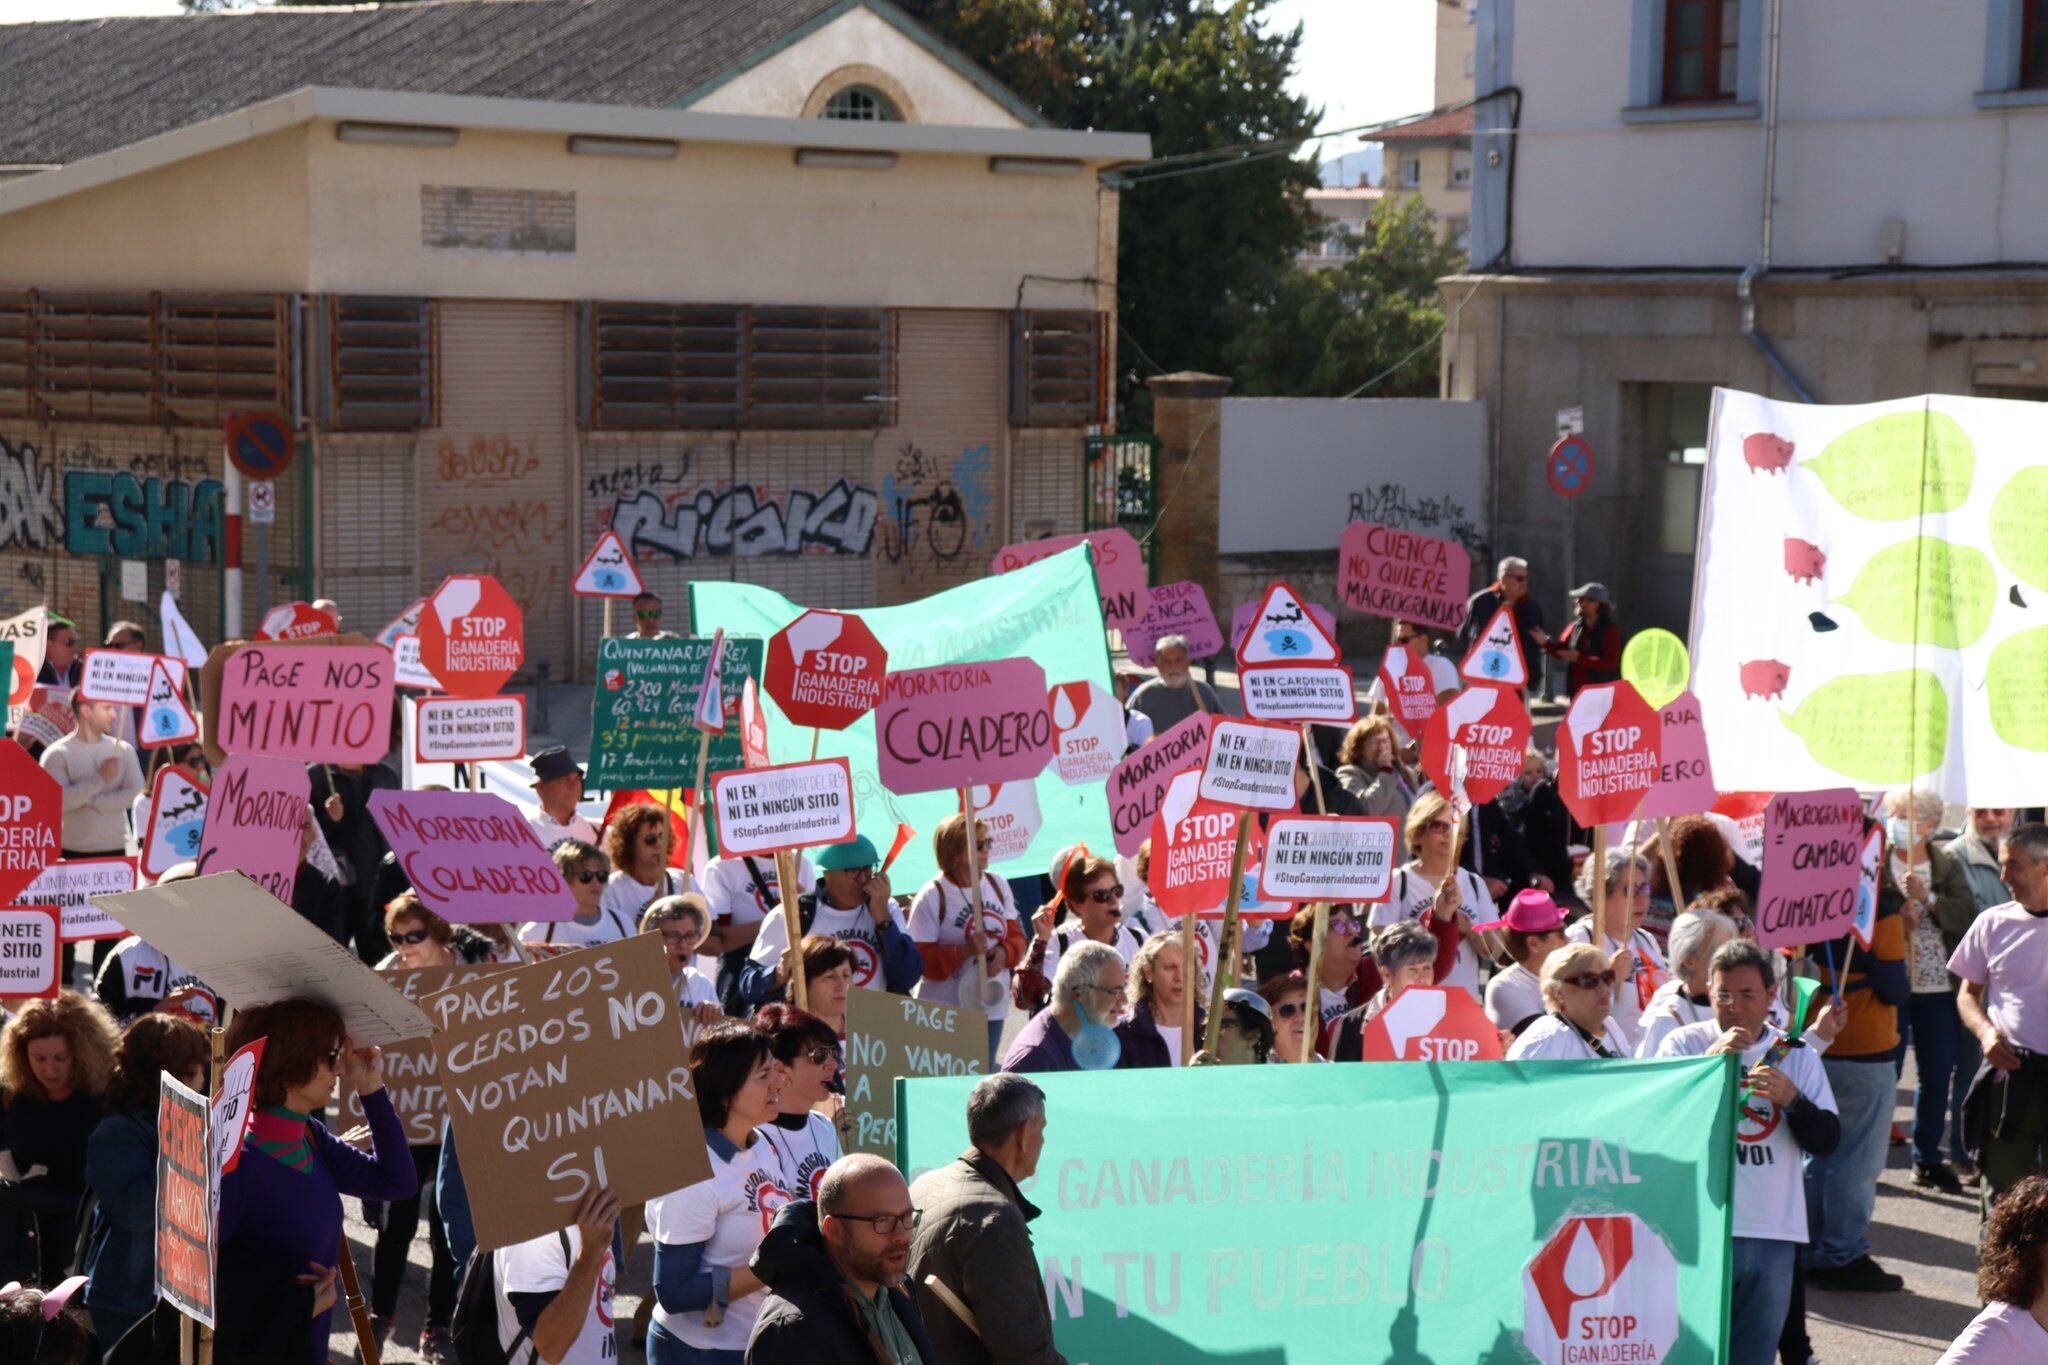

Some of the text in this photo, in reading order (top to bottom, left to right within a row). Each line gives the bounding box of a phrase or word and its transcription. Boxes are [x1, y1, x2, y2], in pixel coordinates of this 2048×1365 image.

[1366, 526, 1447, 567] CUENCA
[1348, 556, 1449, 594] NO QUIERE
[1346, 582, 1466, 627] MACROGRANJAS
[288, 621, 321, 638] STOP
[461, 617, 507, 638] STOP
[450, 637, 521, 656] GANADERÍA
[604, 639, 692, 660] QUINTANAR
[721, 640, 749, 662] REY
[241, 650, 381, 689] PAGE NOS
[446, 654, 518, 673] INDUSTRIAL
[814, 651, 868, 675] STOP
[800, 672, 880, 696] GANADERÍA
[886, 668, 993, 702] MORATORIA
[1251, 676, 1342, 687] NI EN CARDENETE
[1253, 688, 1262, 698] NI
[1265, 688, 1277, 698] EN
[1320, 688, 1344, 699] SITIO
[1402, 675, 1426, 692] STOP
[791, 685, 873, 711] INDUSTRIAL
[228, 700, 376, 750] MINTIO
[428, 706, 515, 721] NI EN CARDENETE
[428, 724, 438, 736] NI
[441, 723, 454, 735] EN
[493, 721, 515, 734] SITIO
[885, 707, 1051, 765] COLADERO
[1466, 724, 1513, 745] STOP
[1591, 726, 1641, 756] STOP
[1066, 737, 1100, 755] STOP
[1220, 733, 1231, 749] NI
[1234, 735, 1247, 751] EN
[1059, 763, 1113, 781] INDUSTRIAL
[1061, 750, 1114, 768] GANADERÍA
[1118, 723, 1207, 797] MORATORIA
[1216, 753, 1228, 768] NI
[1230, 754, 1243, 770] EN
[1274, 760, 1292, 776] SITIO
[1582, 748, 1658, 779] GANADERÍA
[726, 786, 738, 801] NI
[742, 784, 756, 799] EN
[1578, 770, 1655, 799] INDUSTRIAL
[728, 792, 839, 820] NI EN NINGÚN SITIO
[382, 802, 546, 851] MORATORIA
[985, 813, 1015, 830] TOP
[1181, 812, 1236, 843] STOP
[1278, 831, 1291, 846] NI
[1294, 831, 1308, 846] EN
[1275, 847, 1384, 866] NI EN NINGÚN SITIO
[1793, 839, 1857, 870] CAMBIO
[405, 850, 561, 902] COLADERO
[33, 890, 85, 907] NINGÚN
[1763, 888, 1855, 933] CLIMATICO
[3, 942, 42, 958] SITIO
[542, 957, 620, 1001] LOS
[900, 999, 958, 1033] PAGE
[447, 991, 666, 1074] CERDOS NO
[852, 1031, 982, 1076] NO VAMOS
[1419, 1037, 1480, 1062] STOP
[456, 1055, 568, 1115] VOTAN
[854, 1073, 872, 1102] A
[502, 1067, 694, 1153] QUINTANAR
[547, 1145, 609, 1203] SI
[1058, 1141, 1349, 1211] GANADERÍA
[1368, 1137, 1642, 1199] INDUSTRIAL
[1102, 1251, 1182, 1319] TU
[1206, 1237, 1451, 1315] PUEBLO
[1581, 1316, 1637, 1340] STOP
[1568, 1339, 1657, 1364] GANADERÍA
